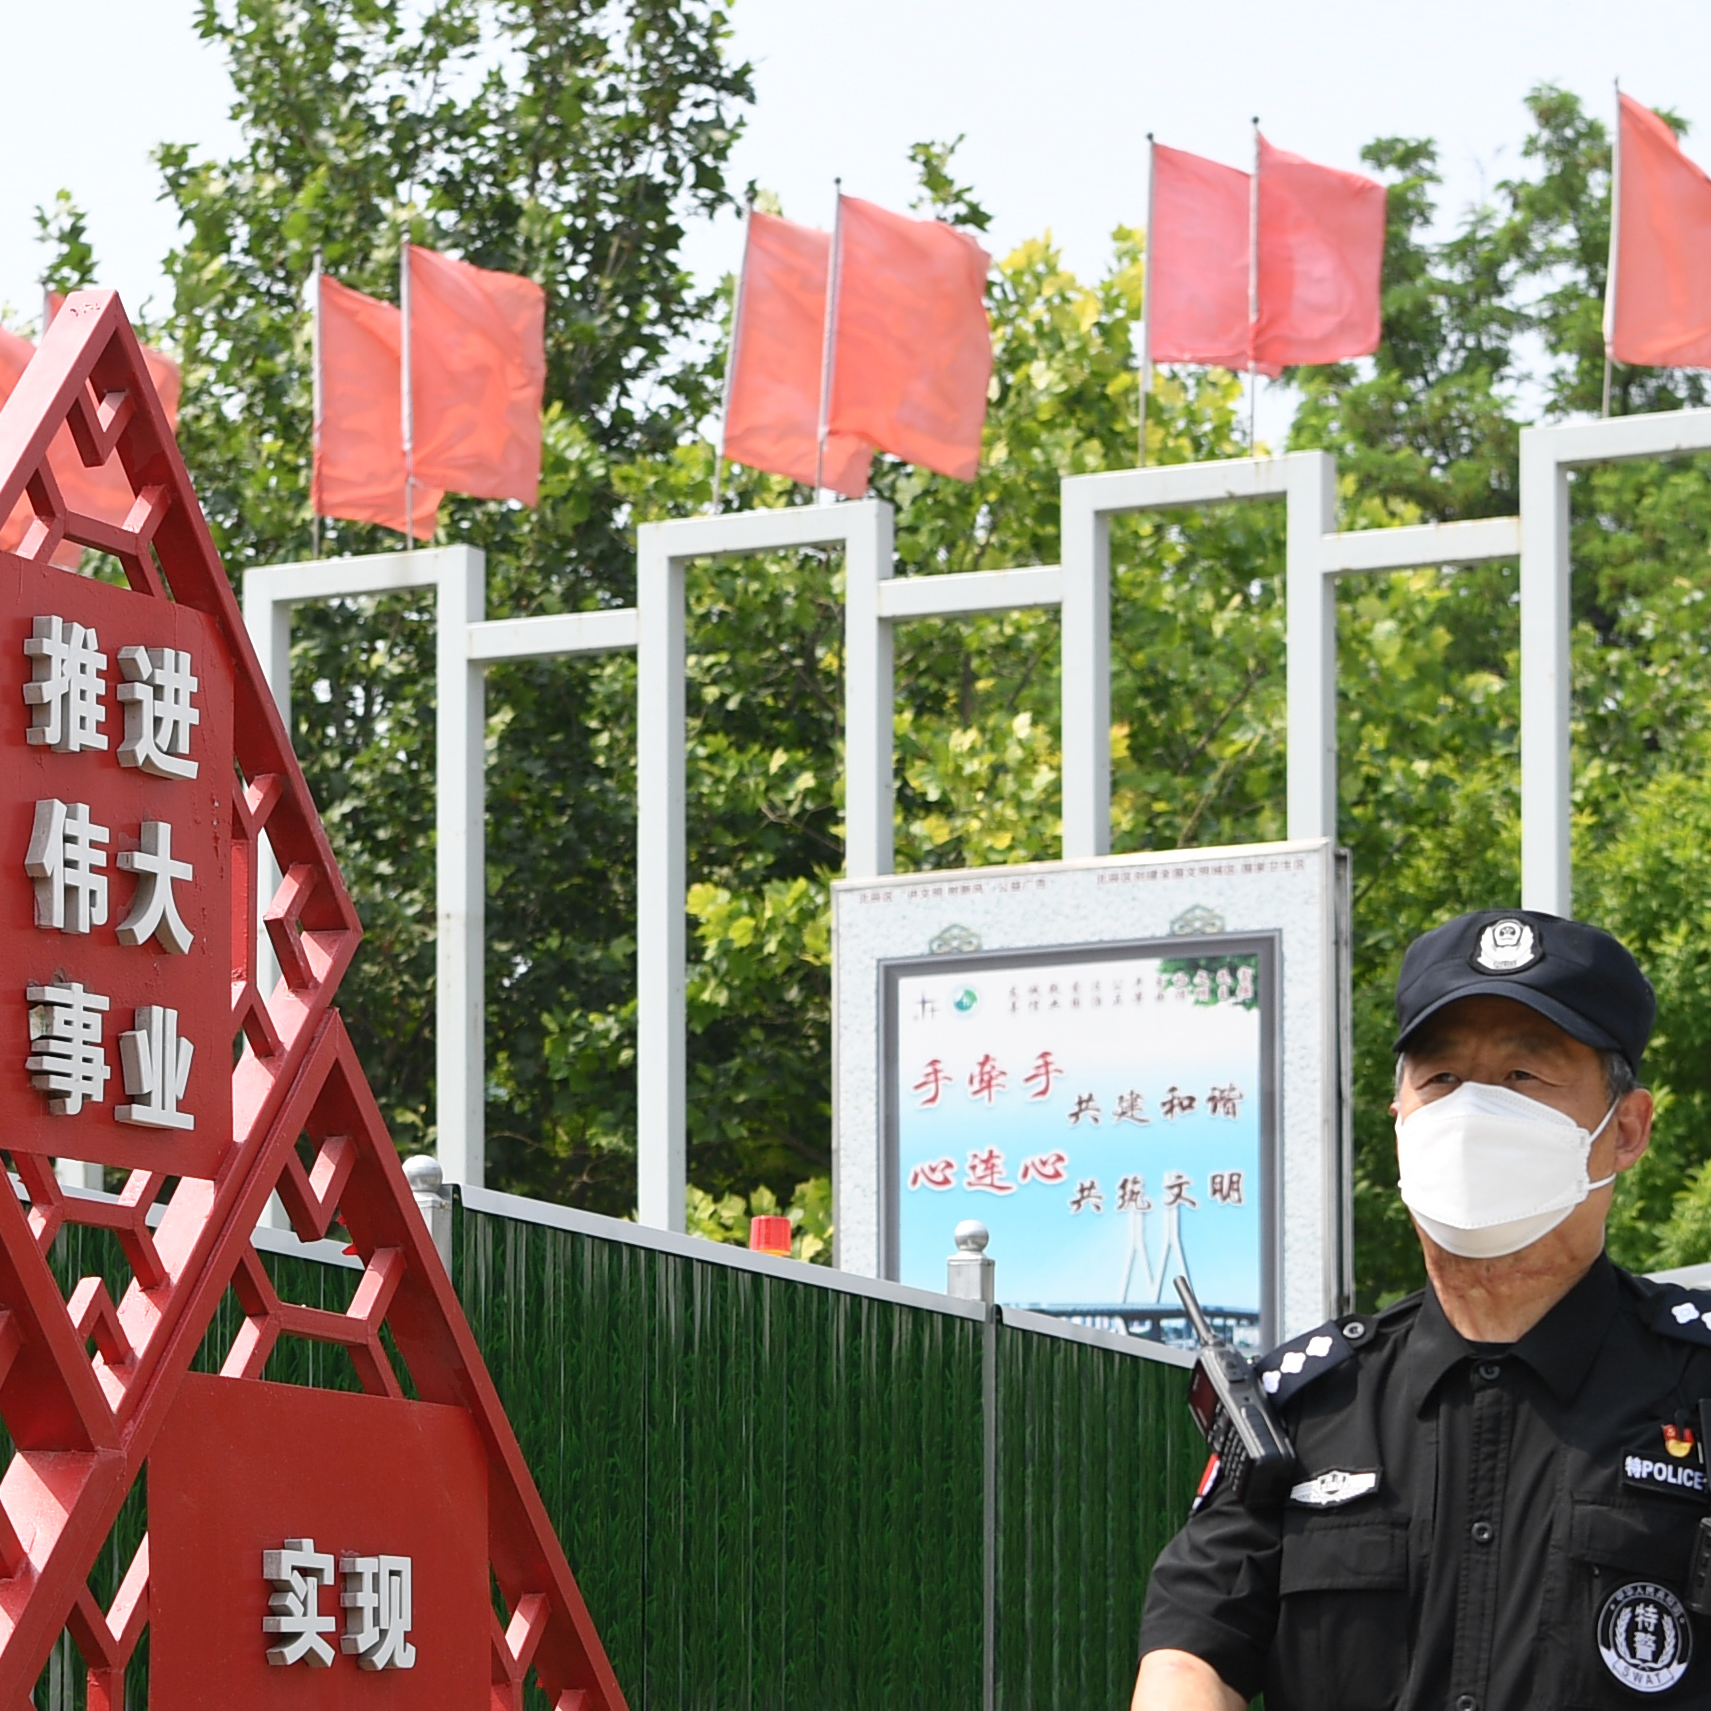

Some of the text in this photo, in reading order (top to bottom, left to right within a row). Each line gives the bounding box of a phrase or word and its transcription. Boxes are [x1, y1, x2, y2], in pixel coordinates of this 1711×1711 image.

[23, 615, 200, 779] 推进
[24, 798, 194, 955] 伟大
[25, 982, 195, 1130] 事业
[911, 1050, 1064, 1106] 手牵手
[1067, 1083, 1245, 1128] 共建和谐
[909, 1149, 1067, 1193] 心连心
[1068, 1172, 1244, 1213] 共筑文明
[1625, 1455, 1705, 1490] 特POLICE
[263, 1538, 417, 1671] 实现
[1633, 1602, 1659, 1661] 特警
[1621, 1666, 1663, 1685] SWAT
